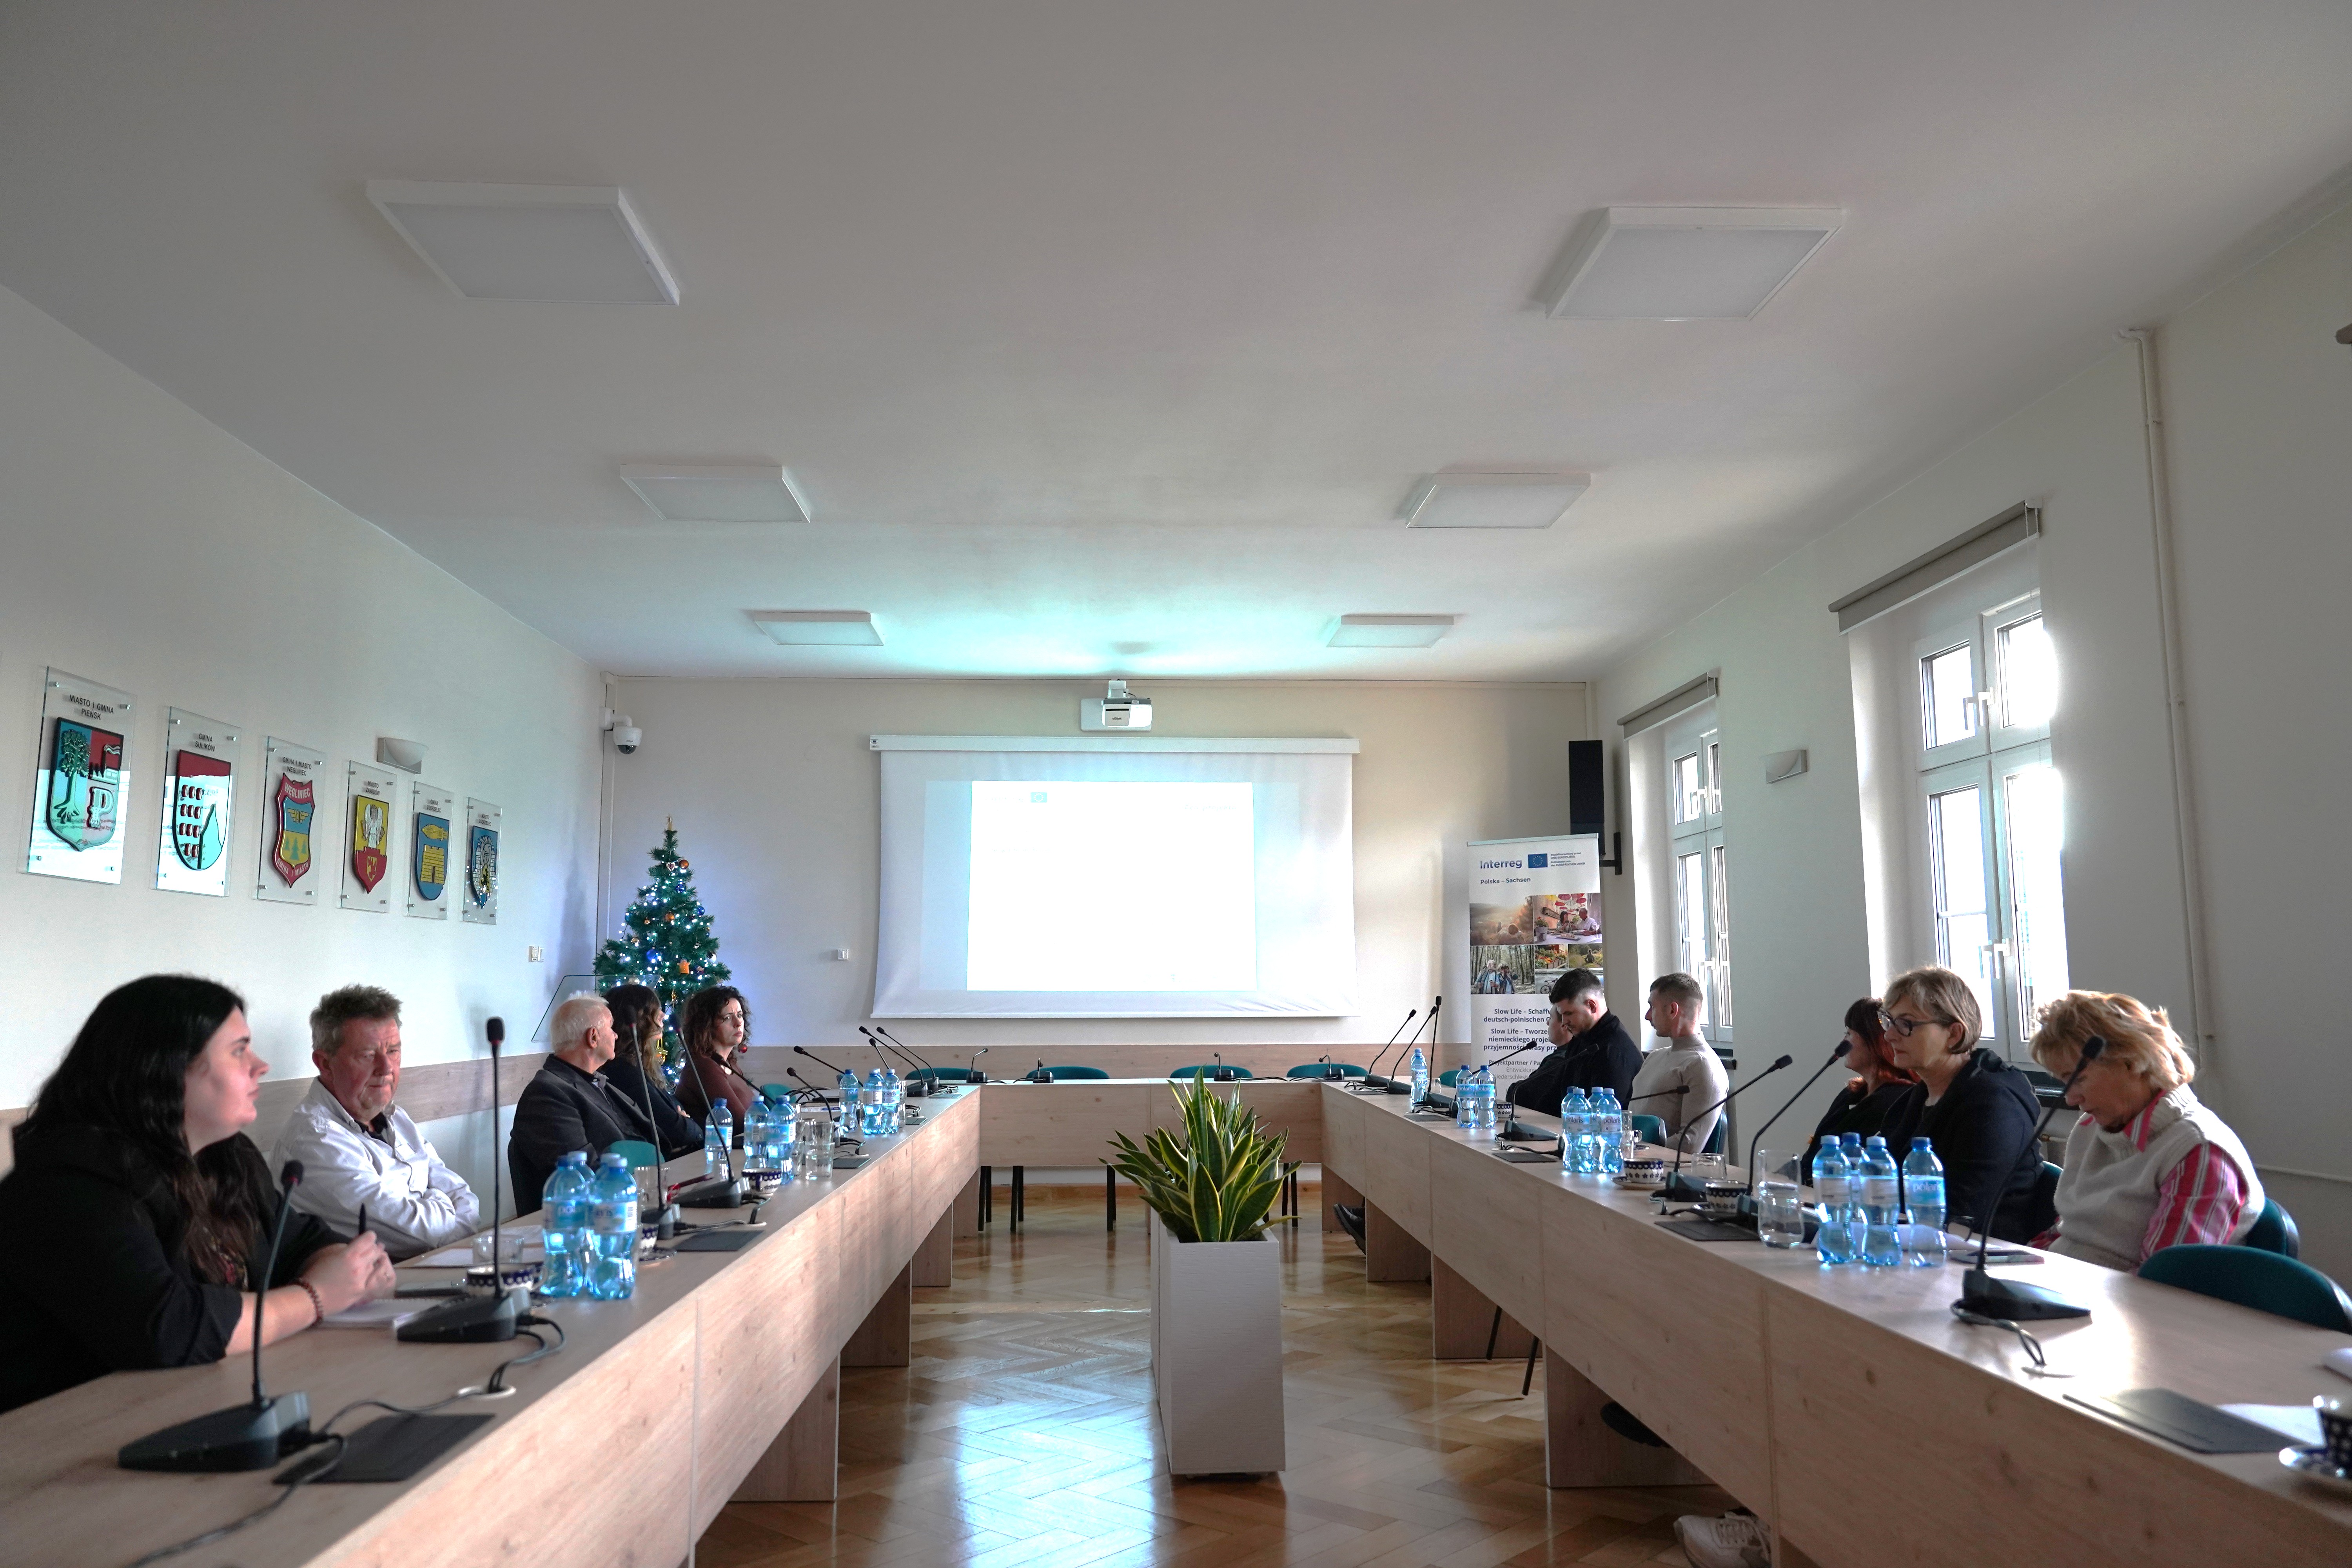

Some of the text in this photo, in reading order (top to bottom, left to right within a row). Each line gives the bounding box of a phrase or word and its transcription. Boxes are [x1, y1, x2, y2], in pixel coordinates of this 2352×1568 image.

[69, 694, 90, 707] MIASTO
[97, 703, 114, 714] GMINA
[81, 708, 101, 720] PIEŃSK
[199, 733, 212, 742] GMINA
[195, 741, 215, 751] SULIKÓW
[283, 757, 294, 765] GMINA
[298, 761, 312, 769] MIASTO
[287, 766, 307, 776] WĘGLINIEC
[285, 782, 310, 799] WĘGLINIEC
[277, 858, 289, 875] GMINA
[295, 862, 309, 876] MIASTO
[1480, 860, 1522, 869] Interreg
